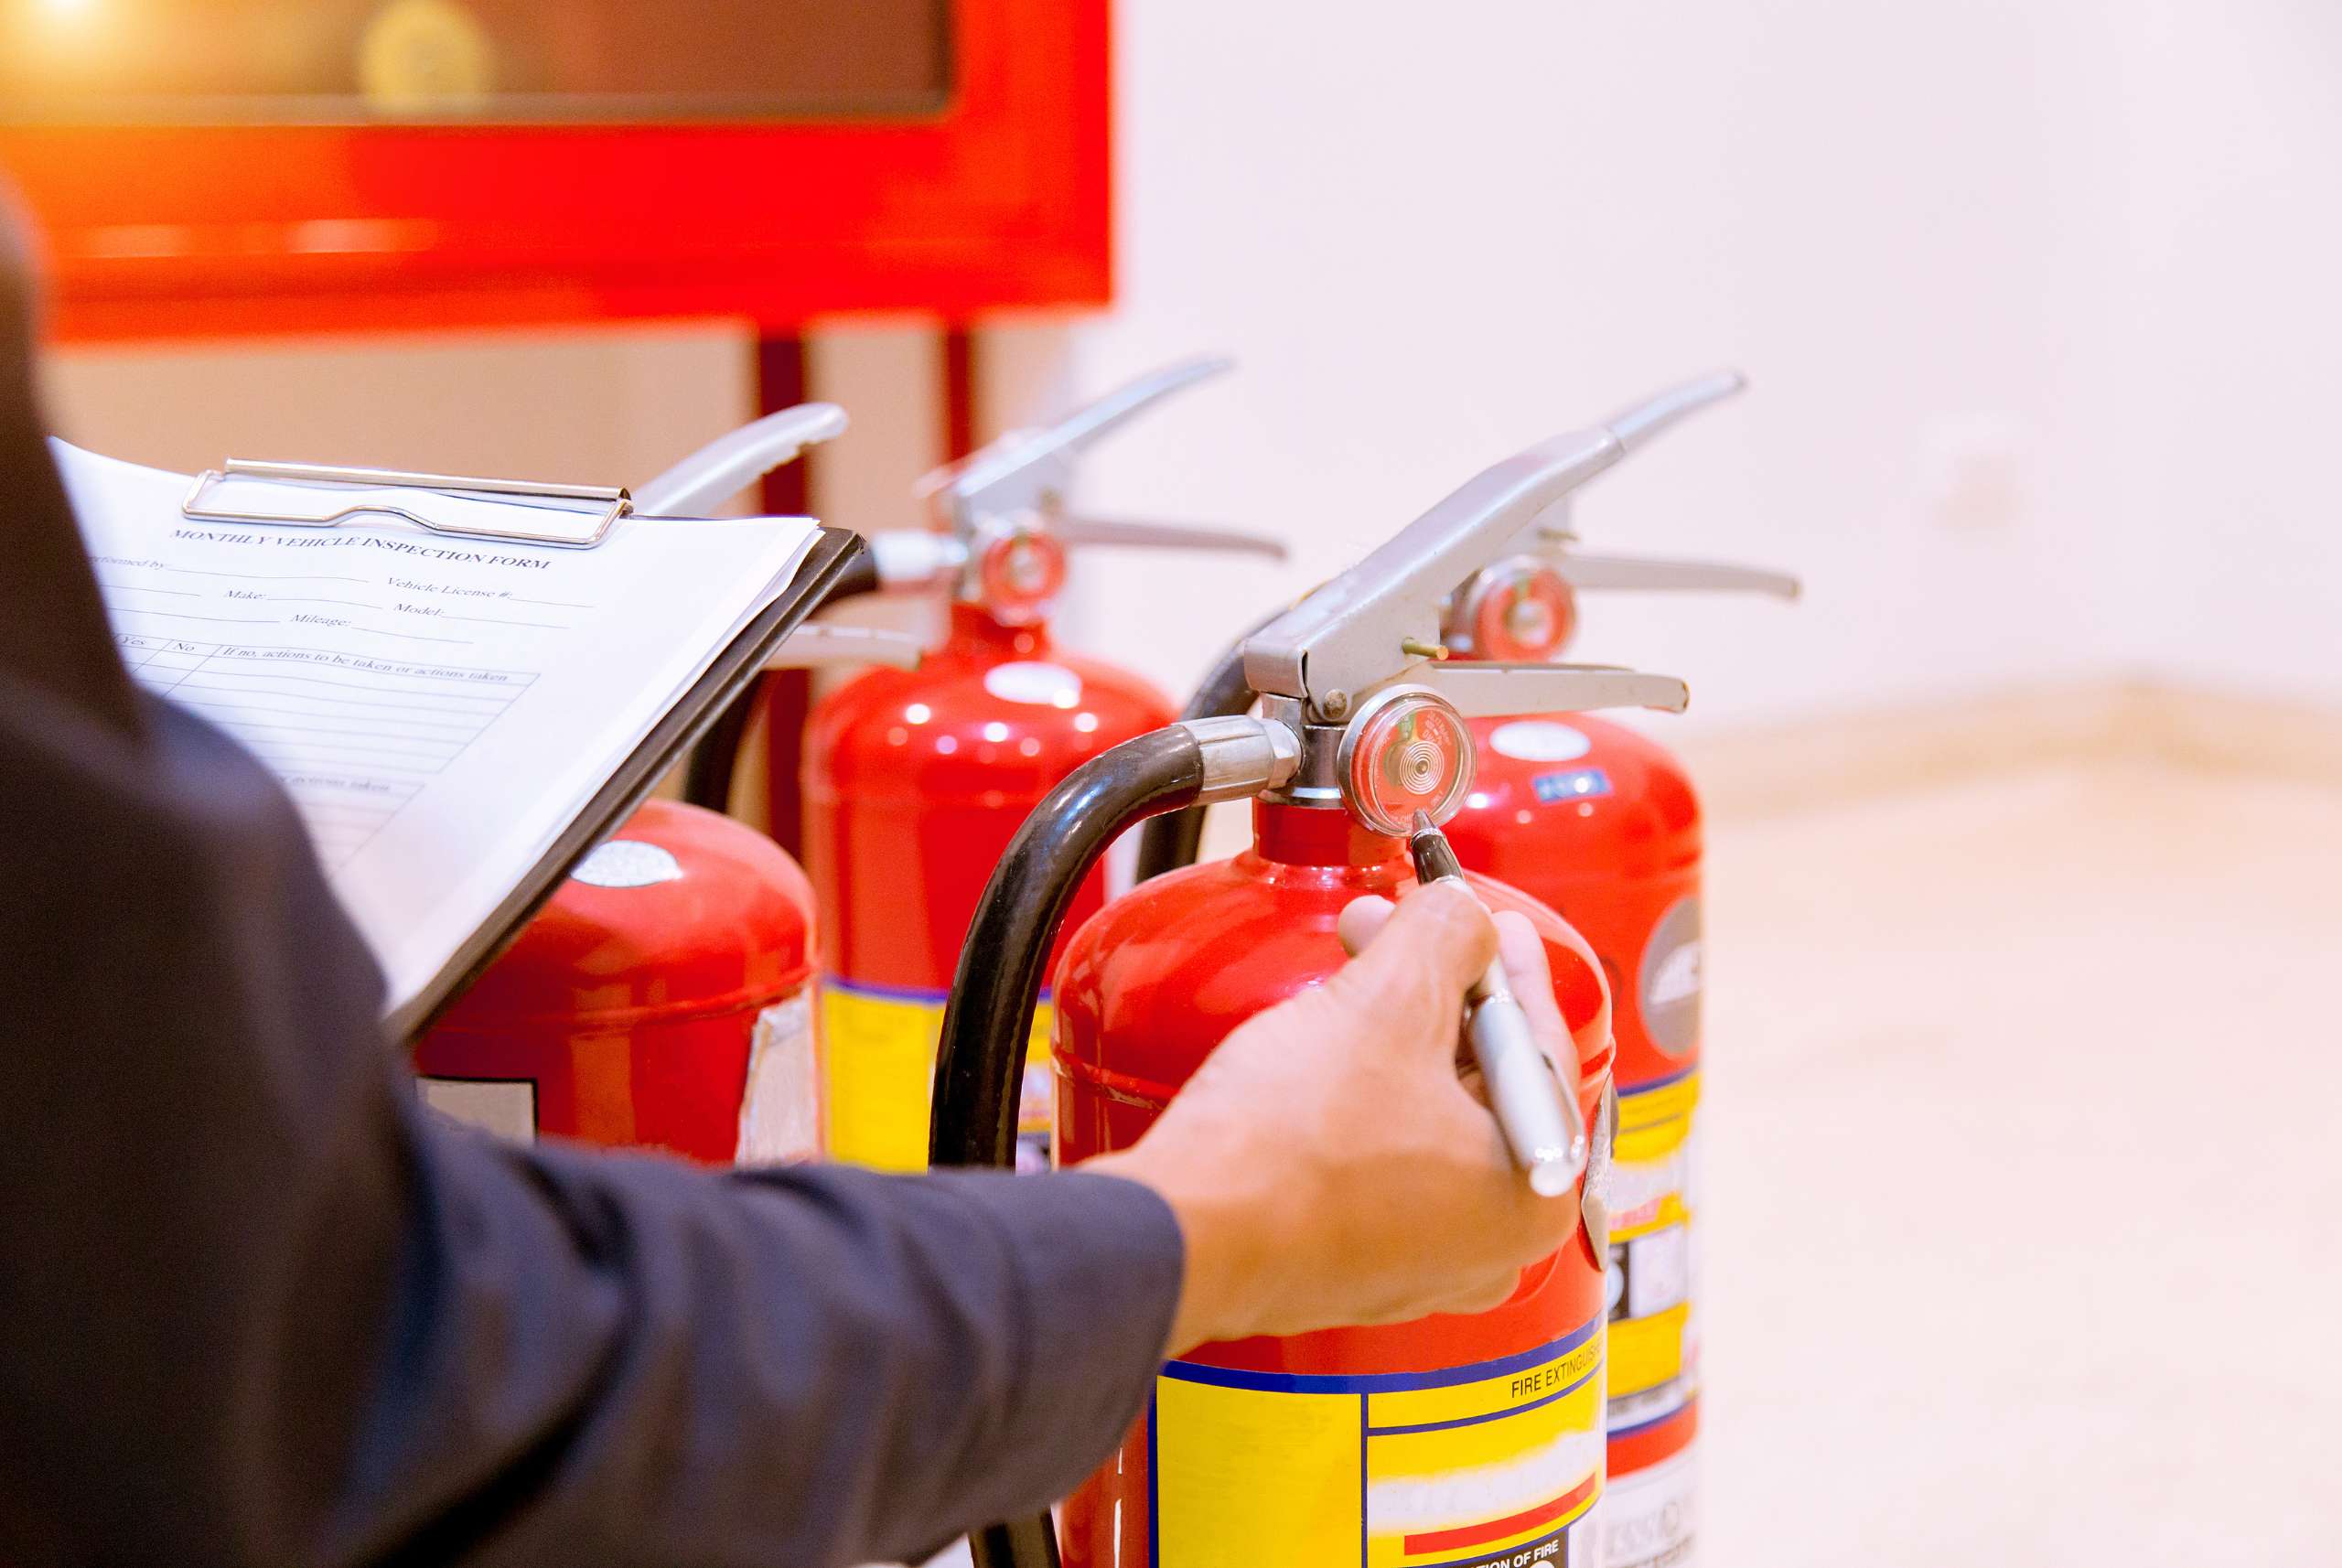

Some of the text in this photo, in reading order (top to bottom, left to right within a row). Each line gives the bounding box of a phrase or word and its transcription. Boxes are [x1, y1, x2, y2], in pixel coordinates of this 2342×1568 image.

[170, 530, 553, 570] MONTHLY VEHICLE INSPECTION FORM
[388, 577, 438, 593] Vehicle
[440, 585, 496, 598] License
[225, 589, 445, 618] Make: Model:
[288, 614, 352, 628] Mileage:
[121, 636, 147, 646] Yes
[172, 642, 196, 652] No
[222, 646, 236, 656] If
[262, 649, 311, 660] actions
[314, 652, 329, 660] to
[331, 654, 350, 665] be
[352, 658, 392, 671] taken
[394, 665, 413, 674] or
[413, 667, 465, 679] actions
[467, 671, 509, 682] taken
[1511, 1372, 1542, 1399] FIRE
[1513, 1552, 1532, 1567] OF
[1534, 1539, 1560, 1561] FIRE
